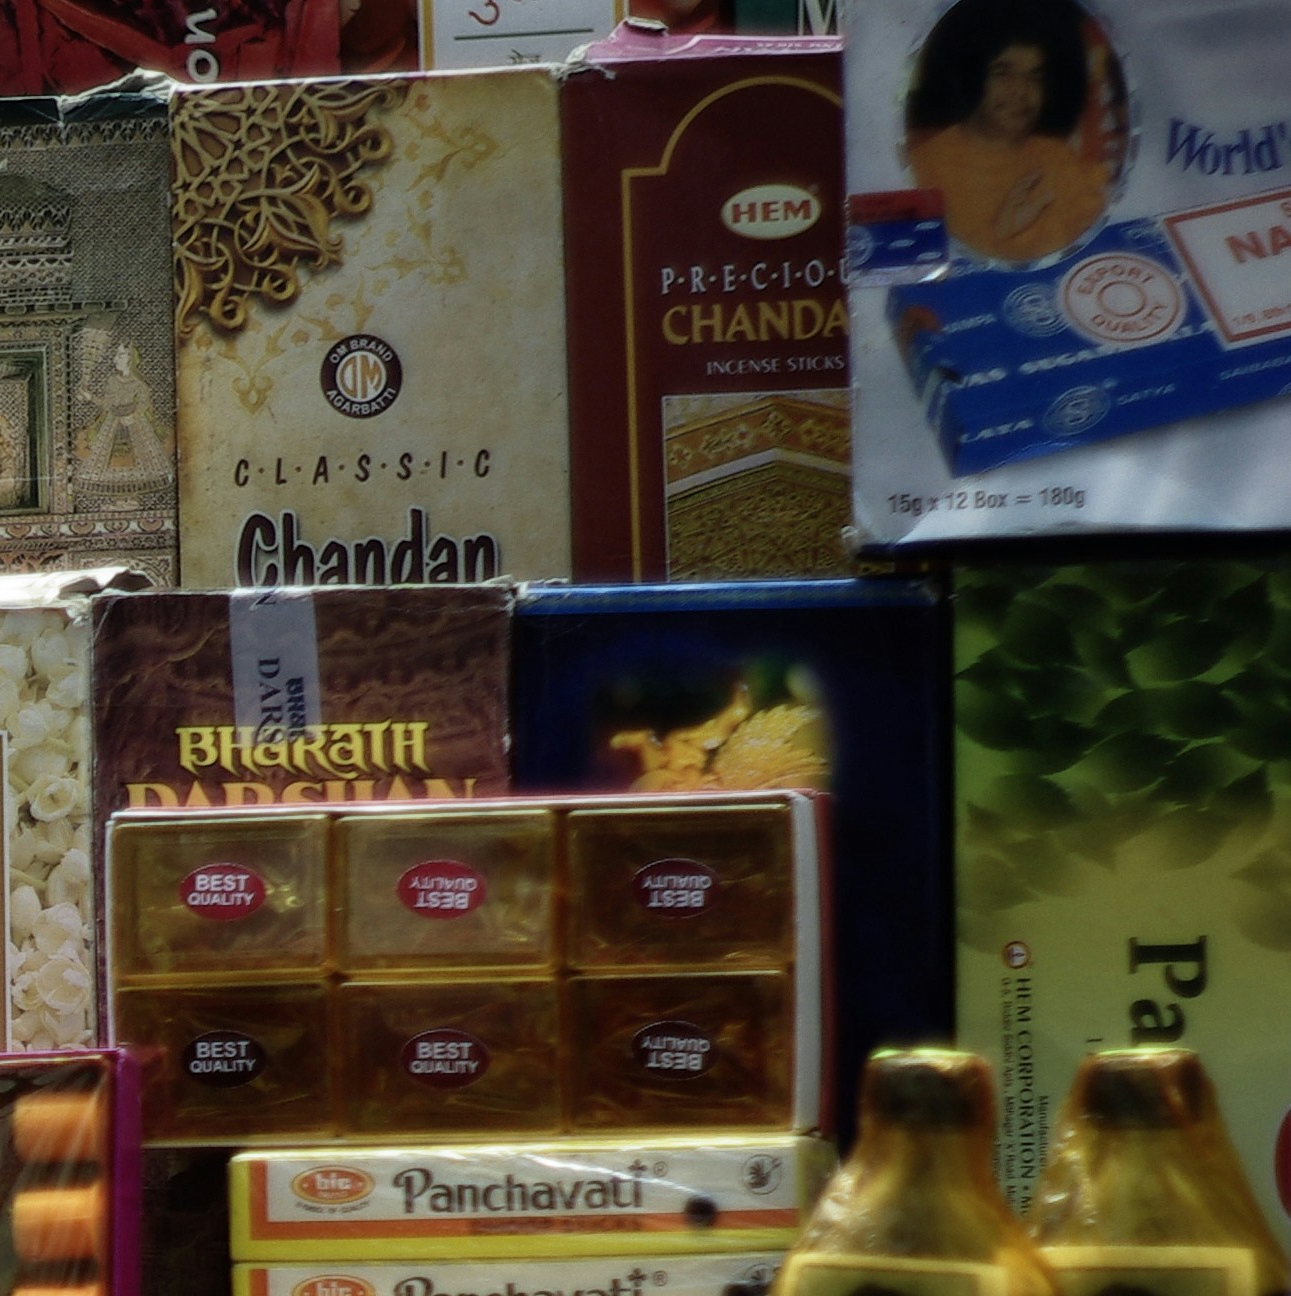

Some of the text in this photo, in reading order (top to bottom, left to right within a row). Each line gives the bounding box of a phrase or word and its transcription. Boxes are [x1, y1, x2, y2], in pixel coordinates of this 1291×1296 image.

[1166, 118, 1291, 176] World'
[732, 199, 812, 224] HEM
[329, 339, 394, 364] OM BRAND
[706, 355, 846, 375] INCENSE STICKS
[326, 387, 397, 416] AGARBATTI
[887, 493, 922, 517] 15g
[927, 497, 939, 512] x
[944, 491, 968, 511] 12
[973, 490, 1009, 509] Box
[1038, 486, 1086, 509] 180g
[233, 506, 500, 588] Chandan
[193, 873, 250, 893] BEST
[187, 890, 255, 908] QUALITY
[1016, 977, 1036, 1181] HEM CORPORATION
[393, 1159, 645, 1214] Panchavati
